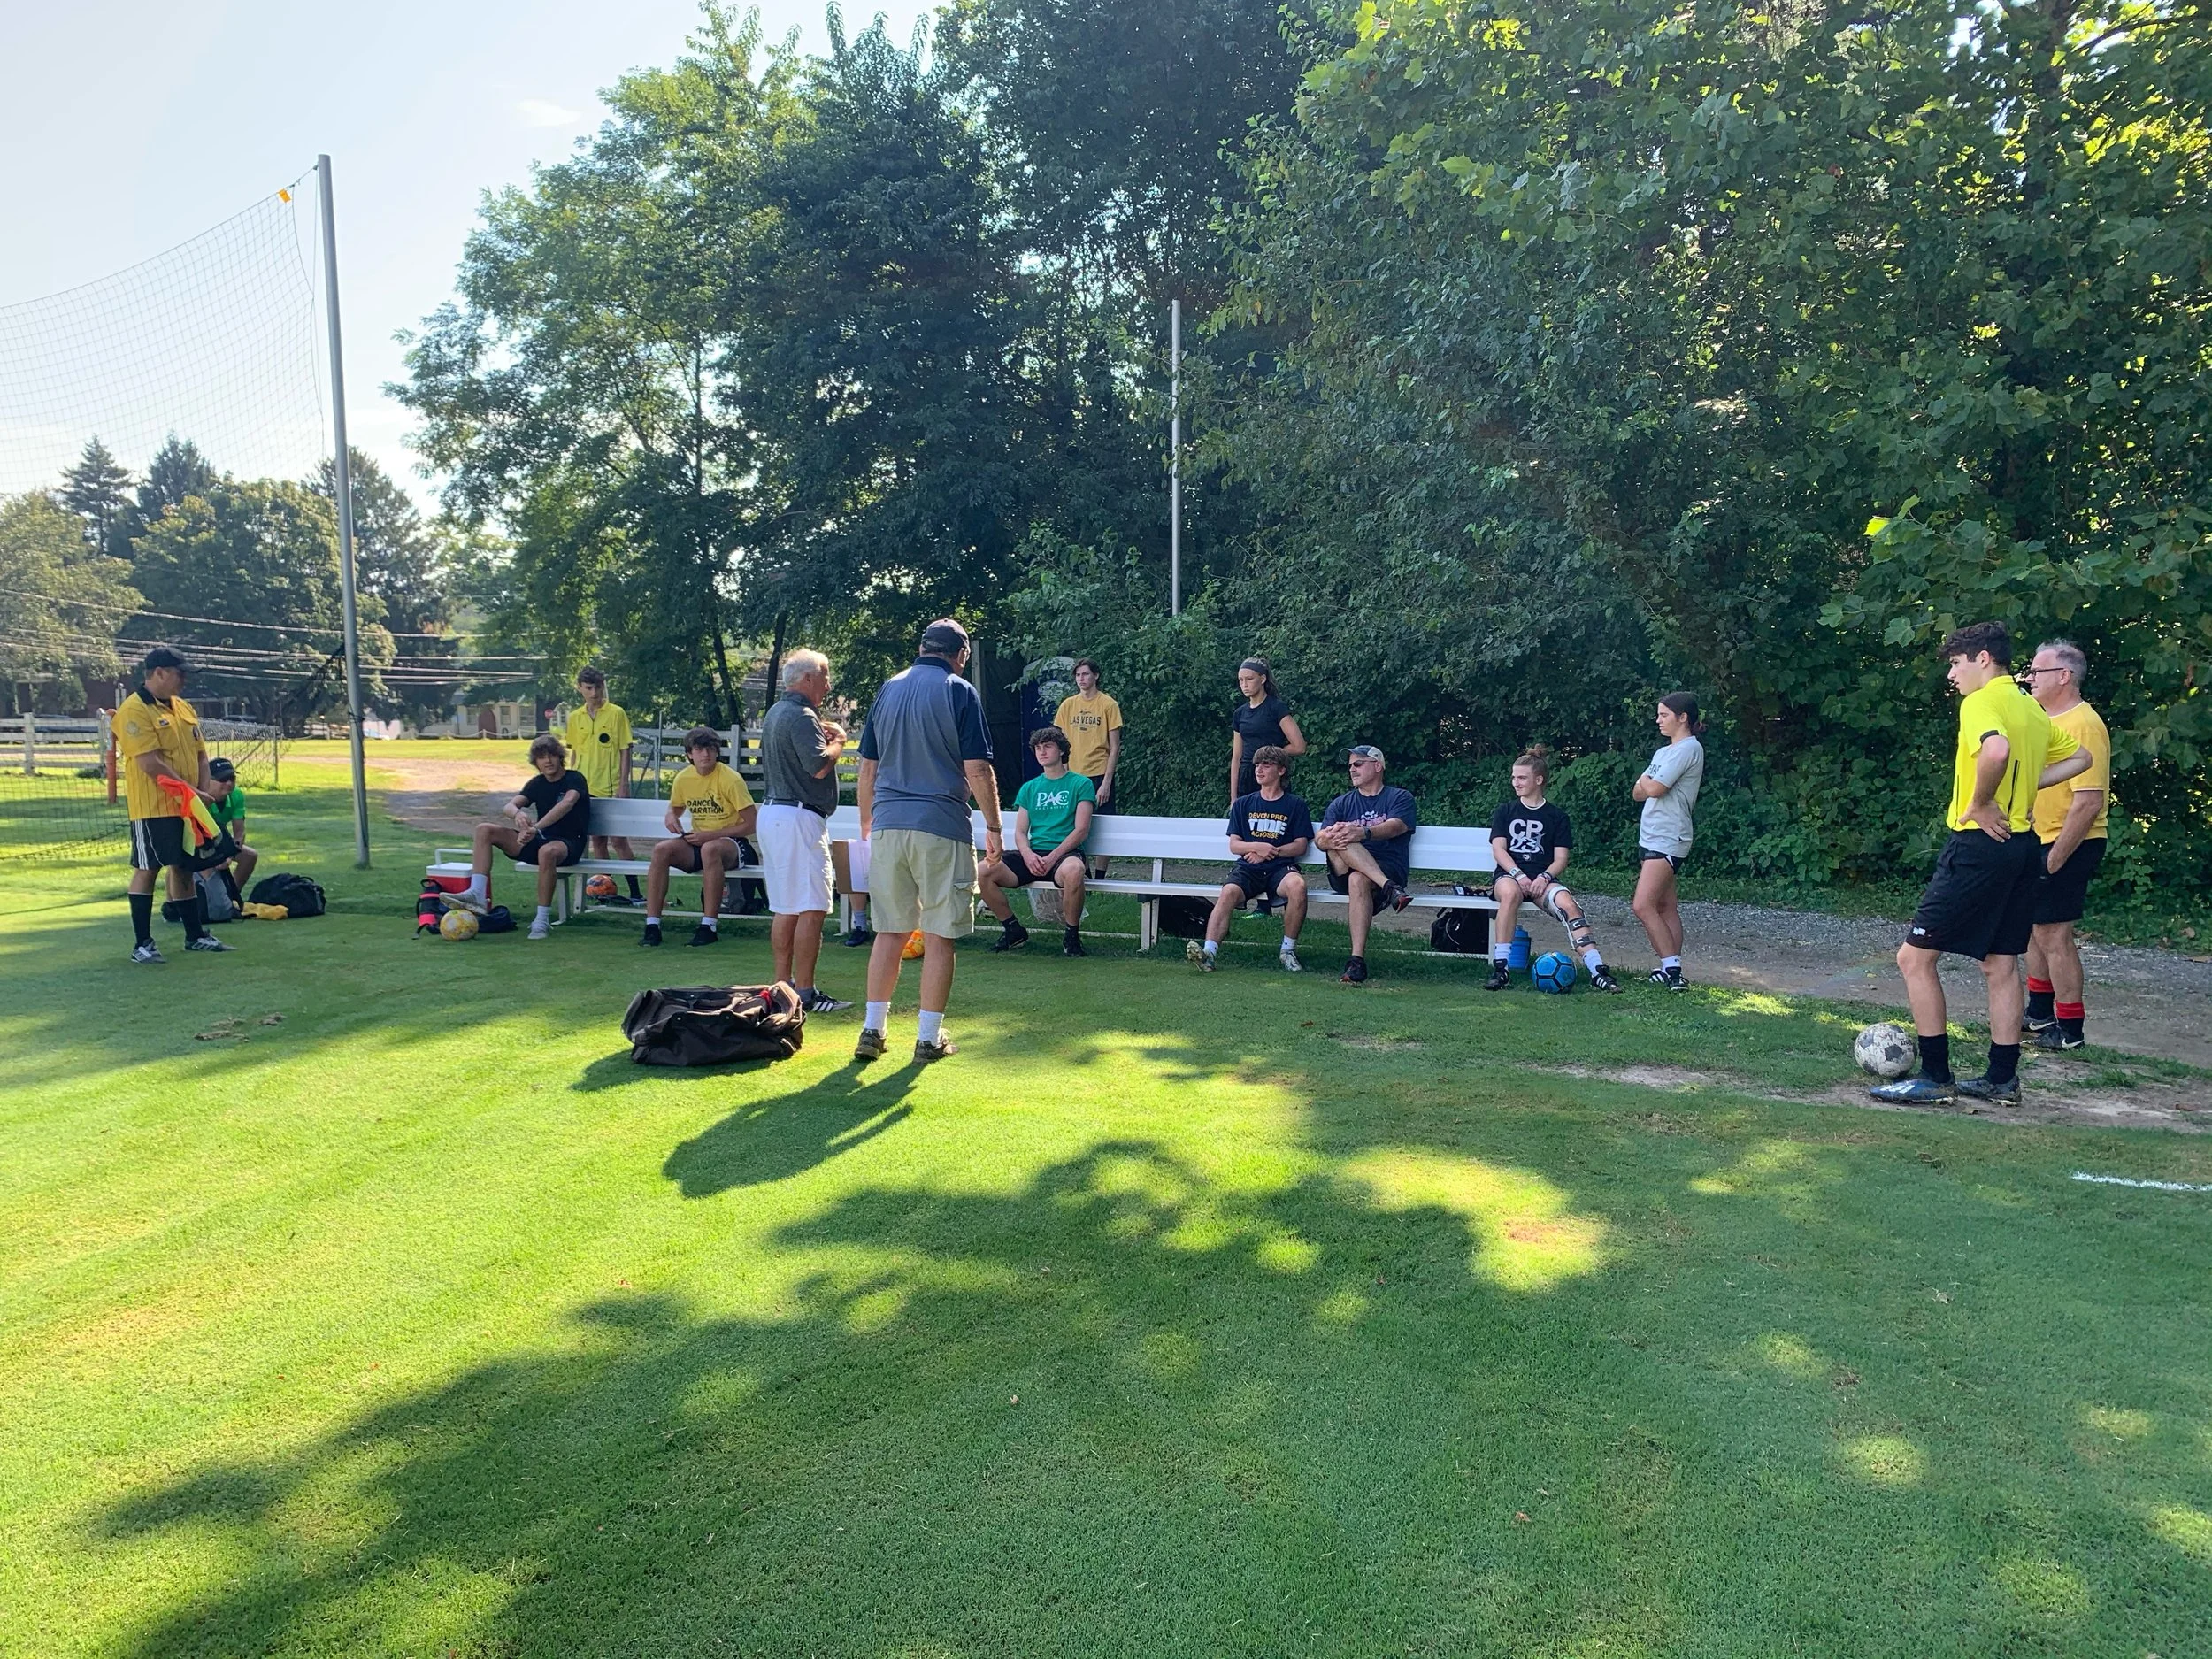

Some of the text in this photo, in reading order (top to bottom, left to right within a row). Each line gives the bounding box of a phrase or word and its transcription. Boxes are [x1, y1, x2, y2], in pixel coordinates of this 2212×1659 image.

[1070, 716, 1102, 726] LAS VEGAS
[1036, 790, 1069, 806] PAC
